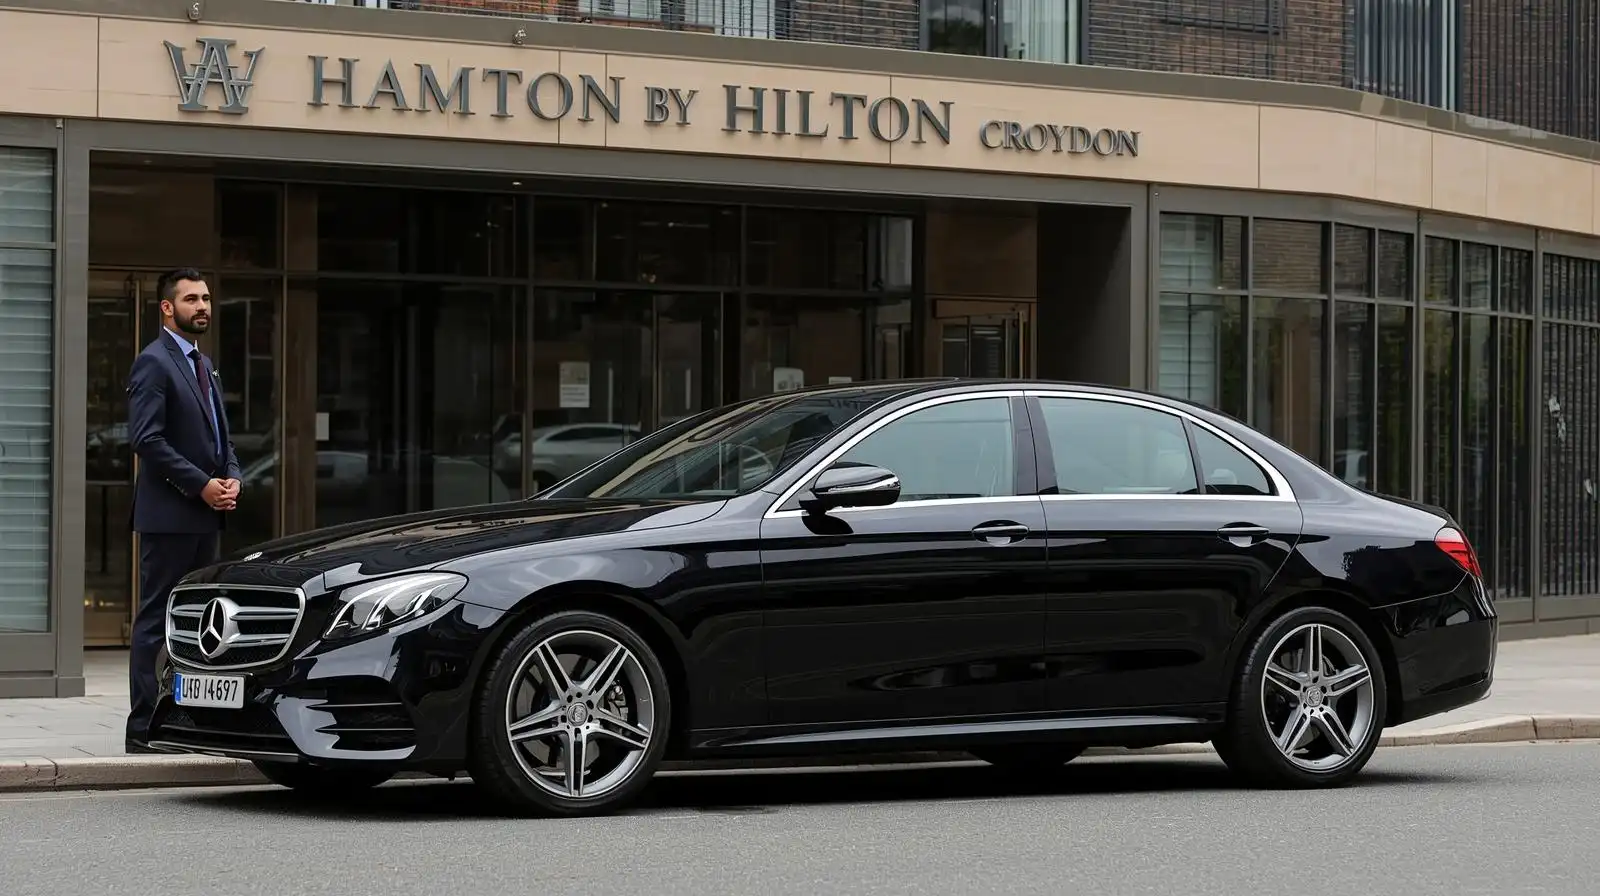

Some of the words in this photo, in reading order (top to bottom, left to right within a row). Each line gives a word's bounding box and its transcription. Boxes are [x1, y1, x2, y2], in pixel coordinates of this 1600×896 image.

[307, 55, 626, 124] HAMTON
[644, 86, 699, 125] BY
[721, 84, 955, 145] HILTON
[979, 119, 1142, 158] CROYDON
